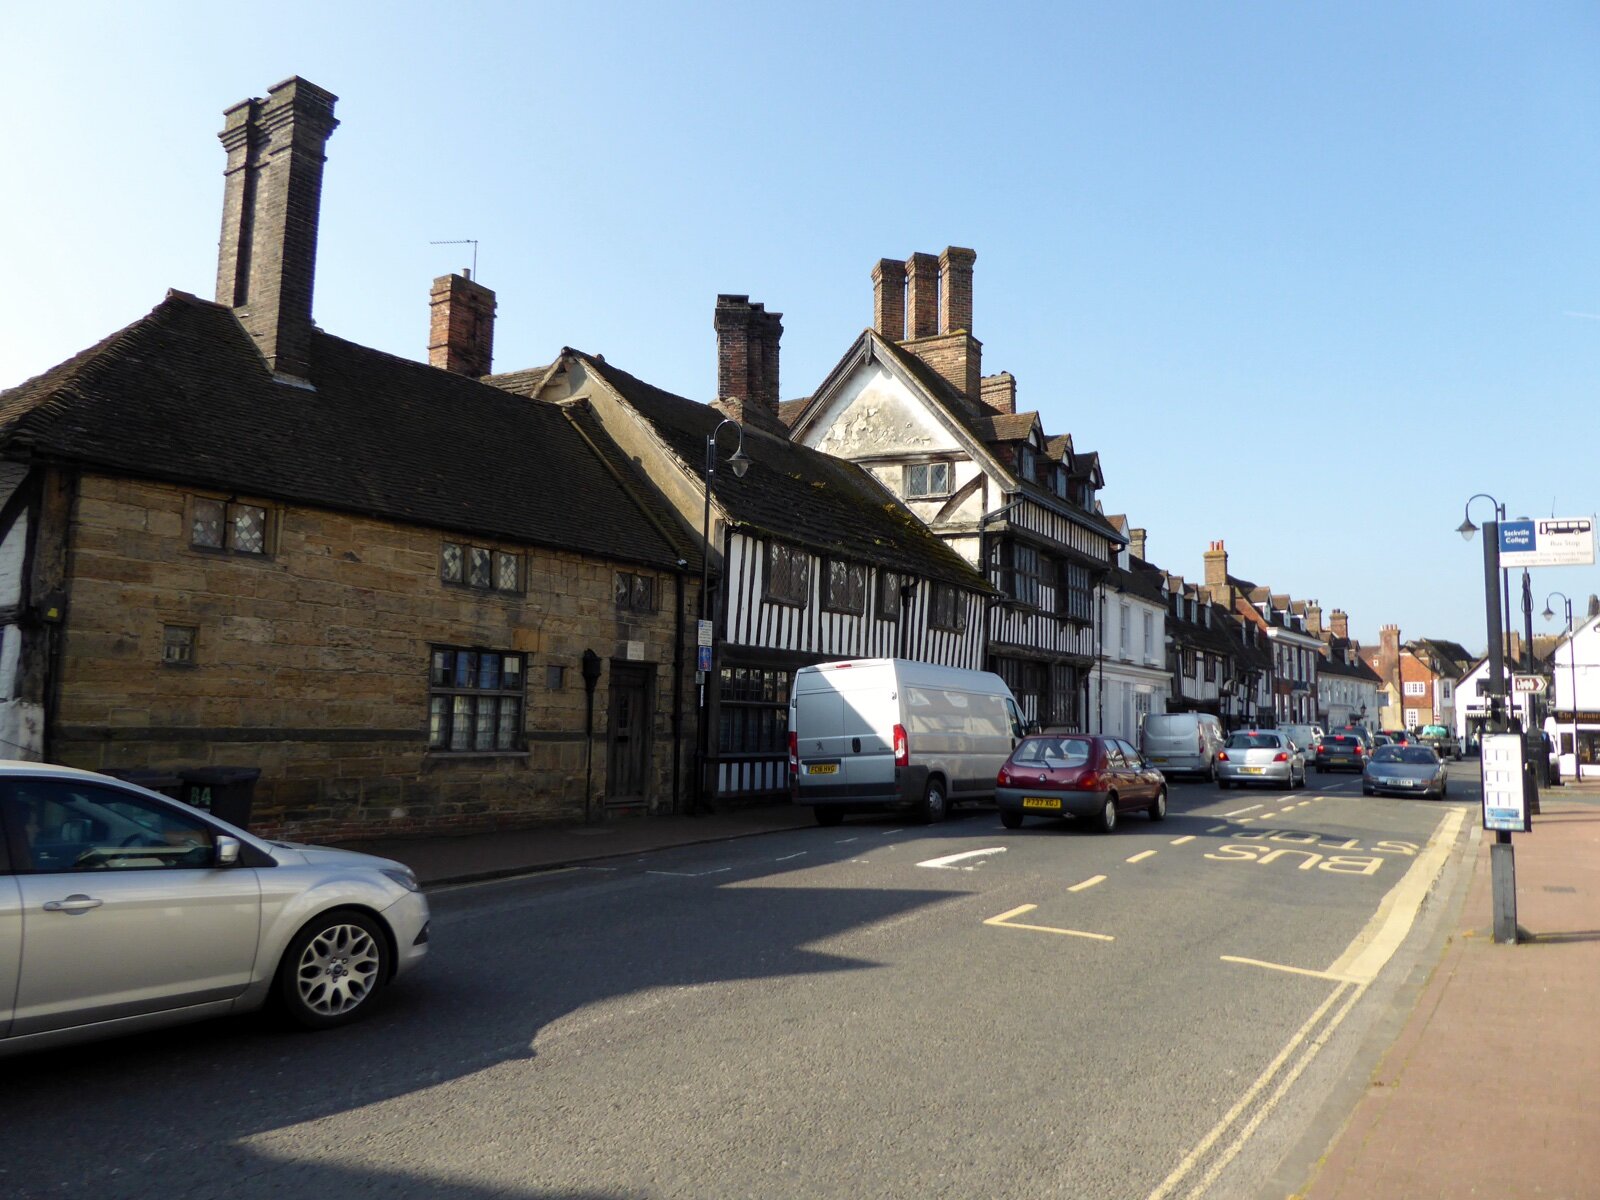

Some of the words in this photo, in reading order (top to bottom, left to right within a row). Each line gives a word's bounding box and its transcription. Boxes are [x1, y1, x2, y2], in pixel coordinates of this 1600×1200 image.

[1565, 539, 1580, 548] Stop
[192, 787, 211, 805] 84
[1026, 798, 1043, 806] P737
[1231, 829, 1420, 856] STOP
[1203, 844, 1385, 876] BUS
